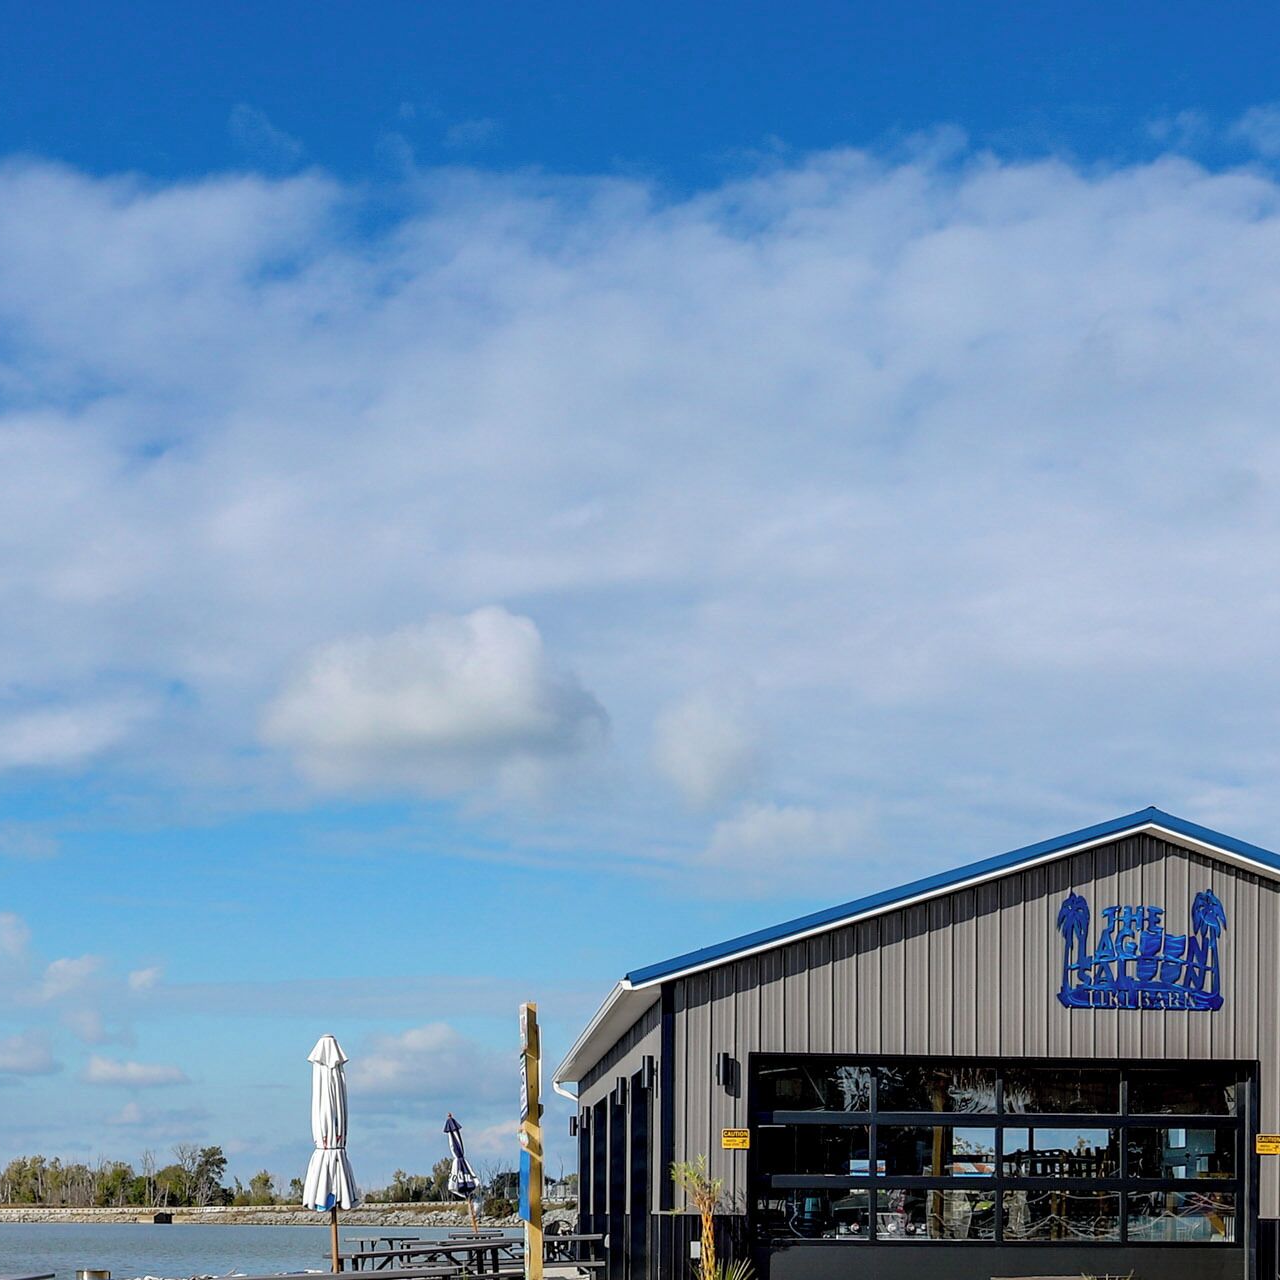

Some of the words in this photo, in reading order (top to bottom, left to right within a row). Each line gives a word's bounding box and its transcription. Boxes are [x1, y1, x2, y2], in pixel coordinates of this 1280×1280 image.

[1102, 905, 1165, 933] THE
[1077, 929, 1210, 967] LAGOON
[1077, 958, 1205, 991] SALOON
[1087, 990, 1129, 1008] TIKI
[1138, 990, 1197, 1008] BARN
[723, 1130, 748, 1138] CAUTION
[1258, 1135, 1280, 1143] CAUTION
